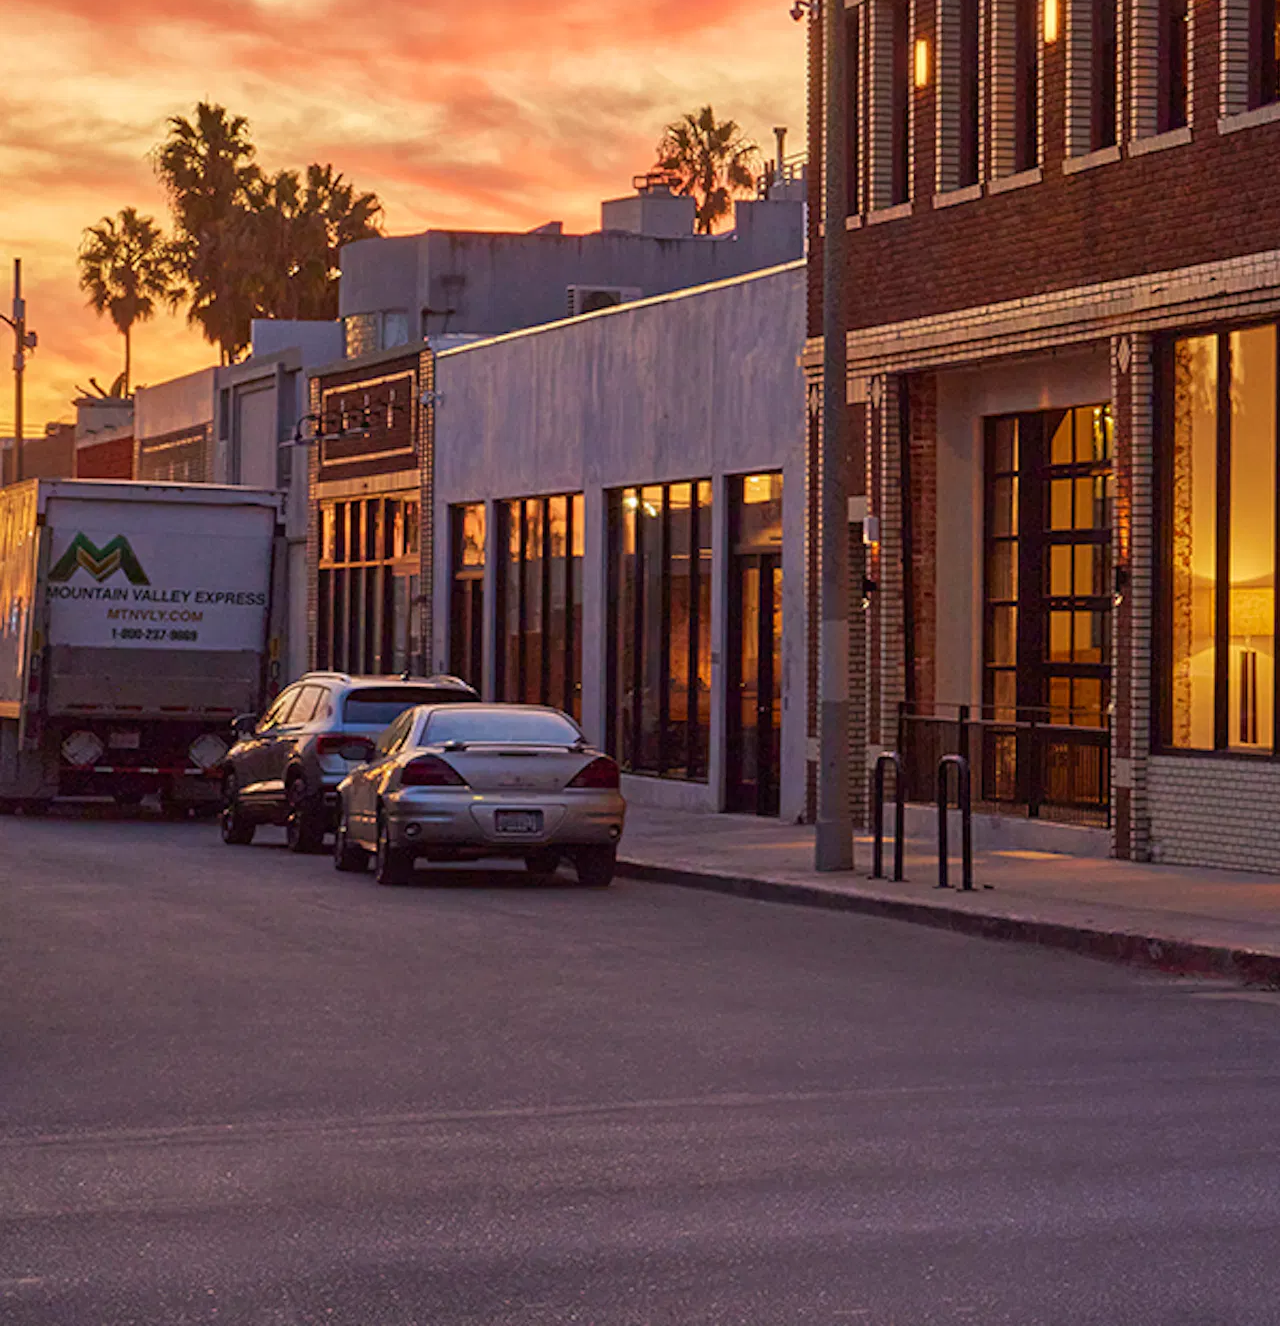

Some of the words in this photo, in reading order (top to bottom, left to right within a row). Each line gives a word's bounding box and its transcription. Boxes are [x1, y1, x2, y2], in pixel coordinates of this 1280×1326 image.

[46, 586, 128, 602] MOUNTAIN
[132, 588, 191, 603] VALLEY
[194, 590, 266, 606] EXPRESS
[107, 608, 203, 623] MTNVLY.COM
